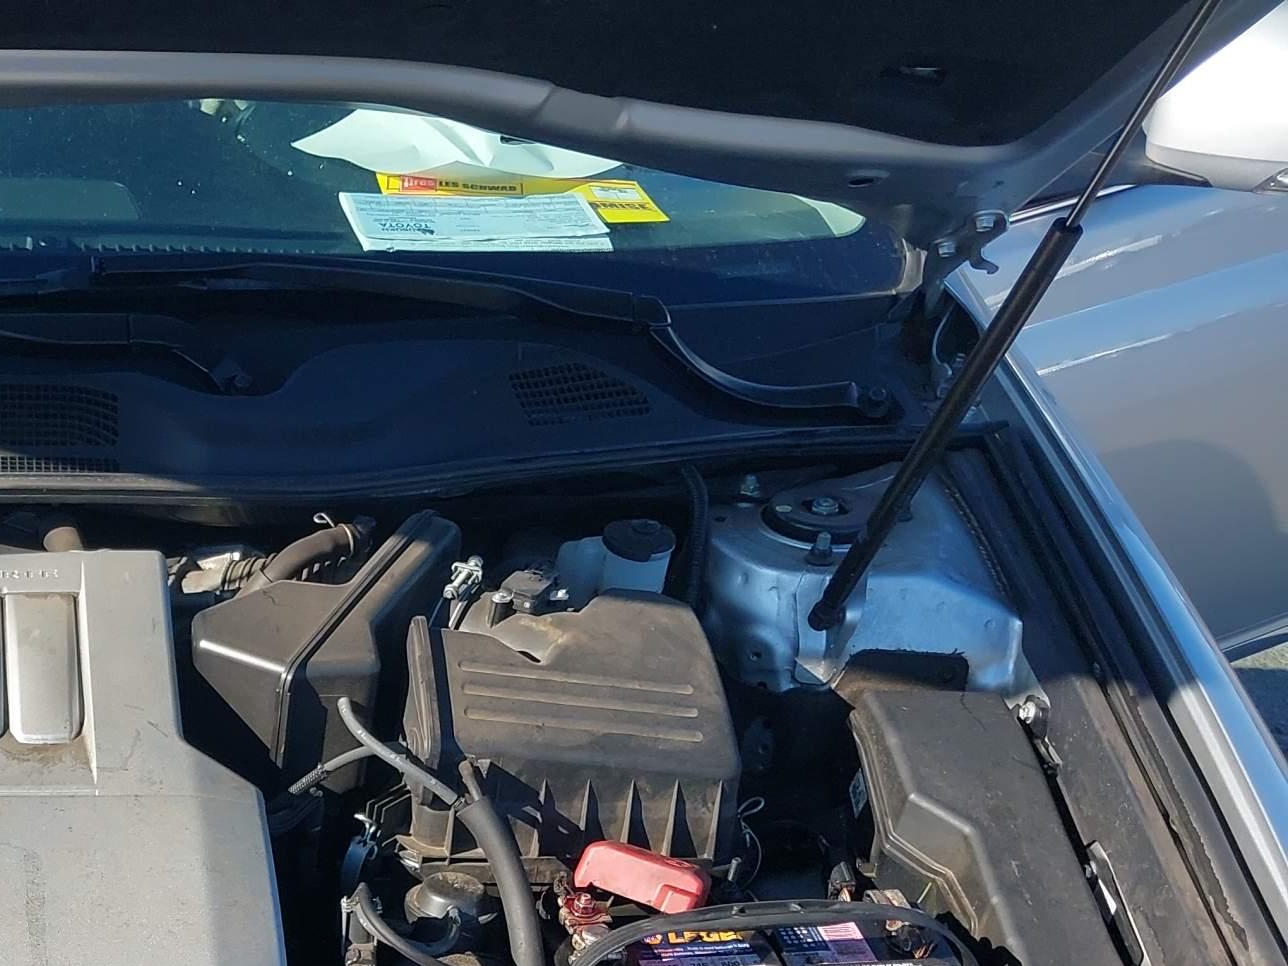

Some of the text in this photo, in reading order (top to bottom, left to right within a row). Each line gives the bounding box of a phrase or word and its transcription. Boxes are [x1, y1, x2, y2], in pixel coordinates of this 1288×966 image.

[439, 180, 459, 188] LES
[462, 182, 517, 192] SCHWAB
[379, 222, 431, 230] TOYOTA
